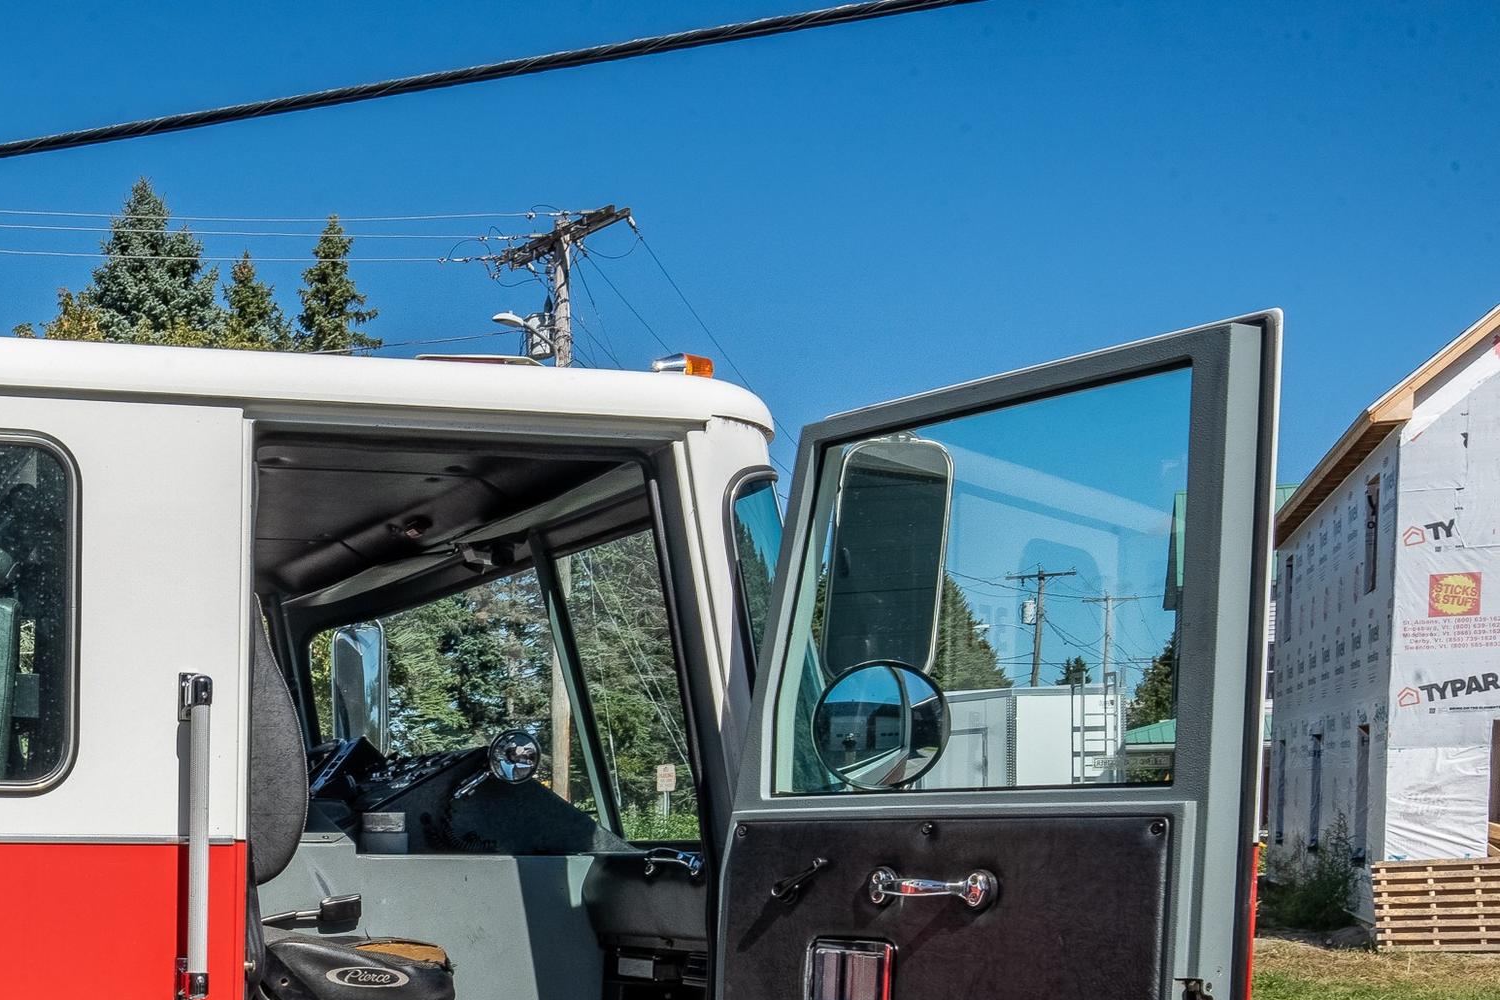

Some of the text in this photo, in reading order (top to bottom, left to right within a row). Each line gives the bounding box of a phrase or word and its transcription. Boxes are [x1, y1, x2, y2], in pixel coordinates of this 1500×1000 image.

[1424, 518, 1455, 540] TY
[1434, 583, 1478, 597] STICKS
[1418, 672, 1500, 702] TYPAR
[344, 969, 391, 984] Pierce
